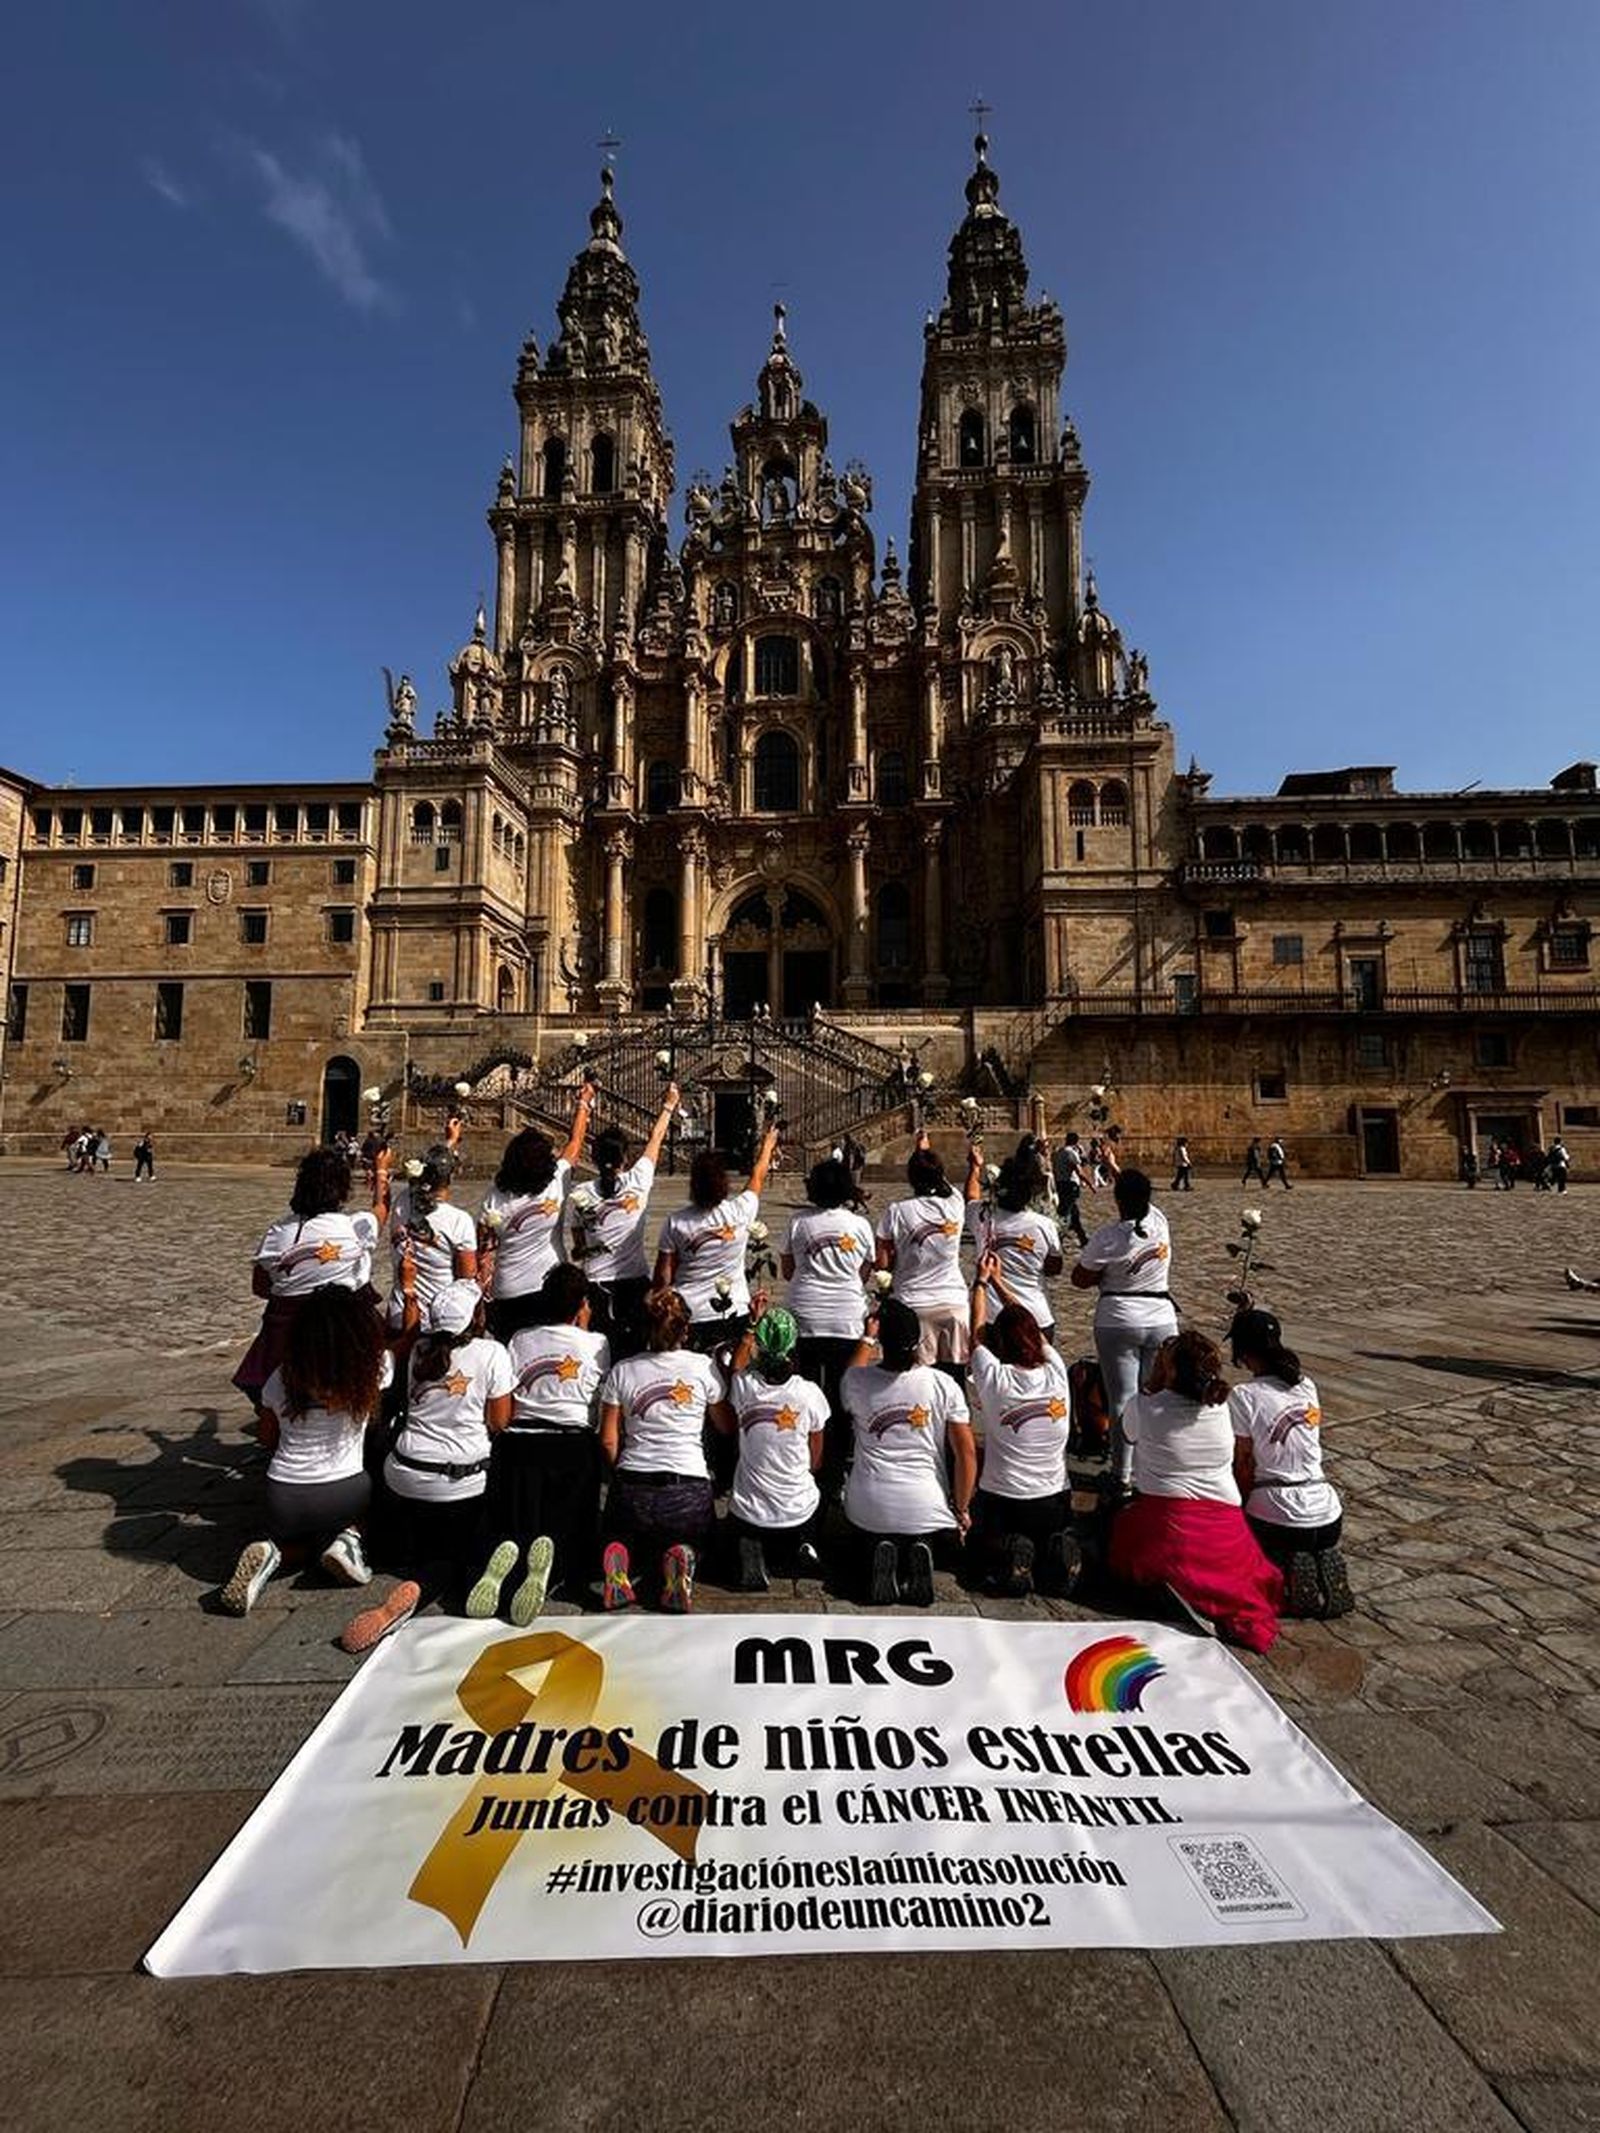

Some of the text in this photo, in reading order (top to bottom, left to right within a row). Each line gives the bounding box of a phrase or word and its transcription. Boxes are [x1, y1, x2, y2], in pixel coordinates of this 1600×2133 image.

[734, 1637, 954, 1686] MRG
[376, 1721, 634, 1778] Madres
[656, 1719, 739, 1774] de
[765, 1716, 948, 1771] niños
[967, 1725, 1251, 1778] estrellas
[463, 1786, 1183, 1837] Juntas contra el CÁNCER INFANTIL
[636, 1892, 1051, 1938] @diariodeuncamino2
